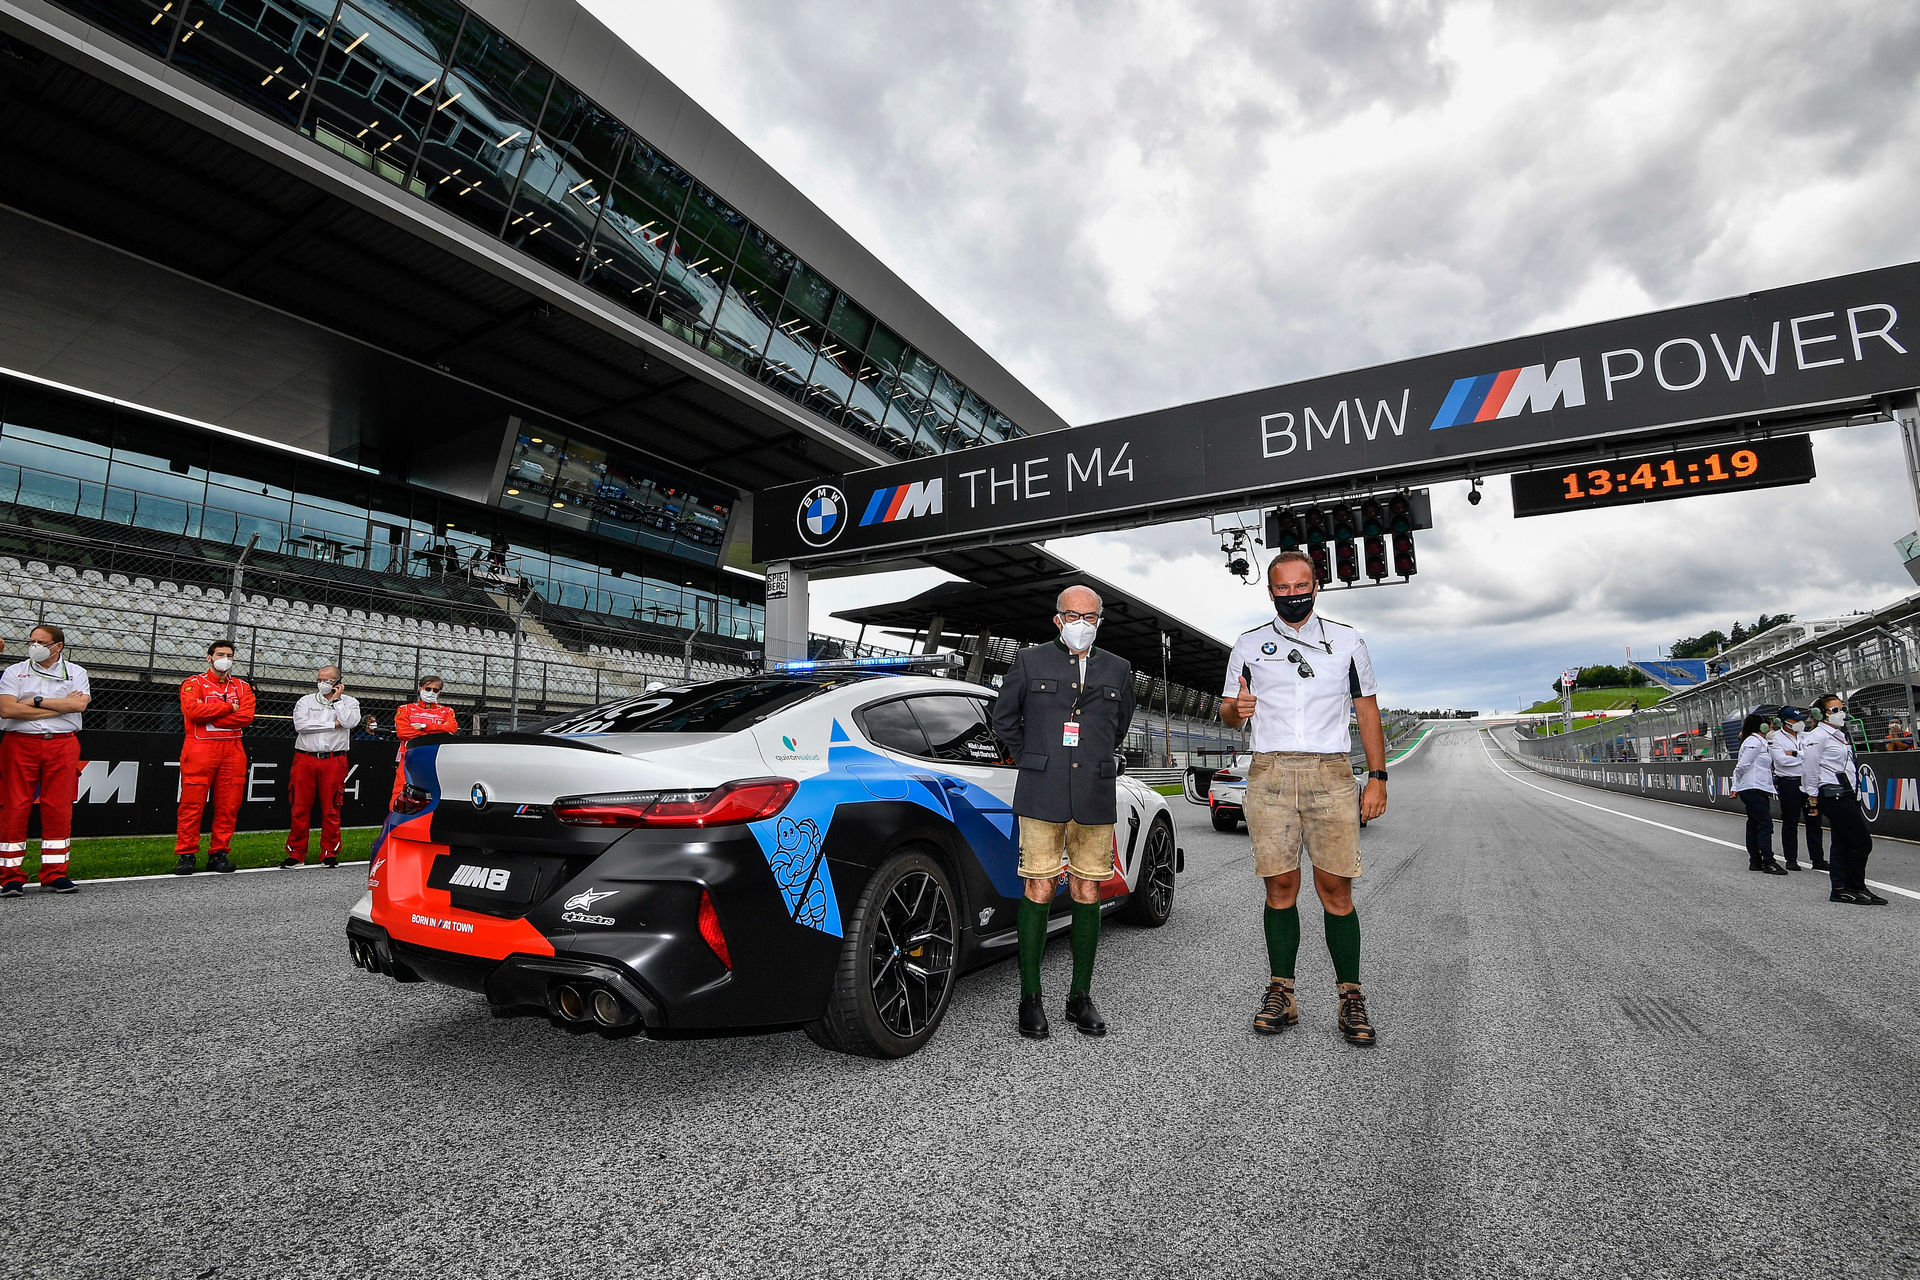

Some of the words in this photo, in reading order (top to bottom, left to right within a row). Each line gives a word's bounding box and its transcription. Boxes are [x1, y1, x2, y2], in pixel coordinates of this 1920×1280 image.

[1260, 388, 1410, 459] BMW
[1601, 302, 1908, 401] POWER
[958, 457, 1051, 508] THE
[1066, 442, 1134, 492] M4
[1563, 448, 1759, 500] 13:41:19
[803, 488, 841, 508] BMW
[767, 581, 787, 592] BERG
[1900, 778, 1920, 812] M
[464, 865, 511, 891] M8
[411, 914, 430, 926] BORN
[429, 917, 437, 928] IN
[453, 921, 474, 933] TOWN
